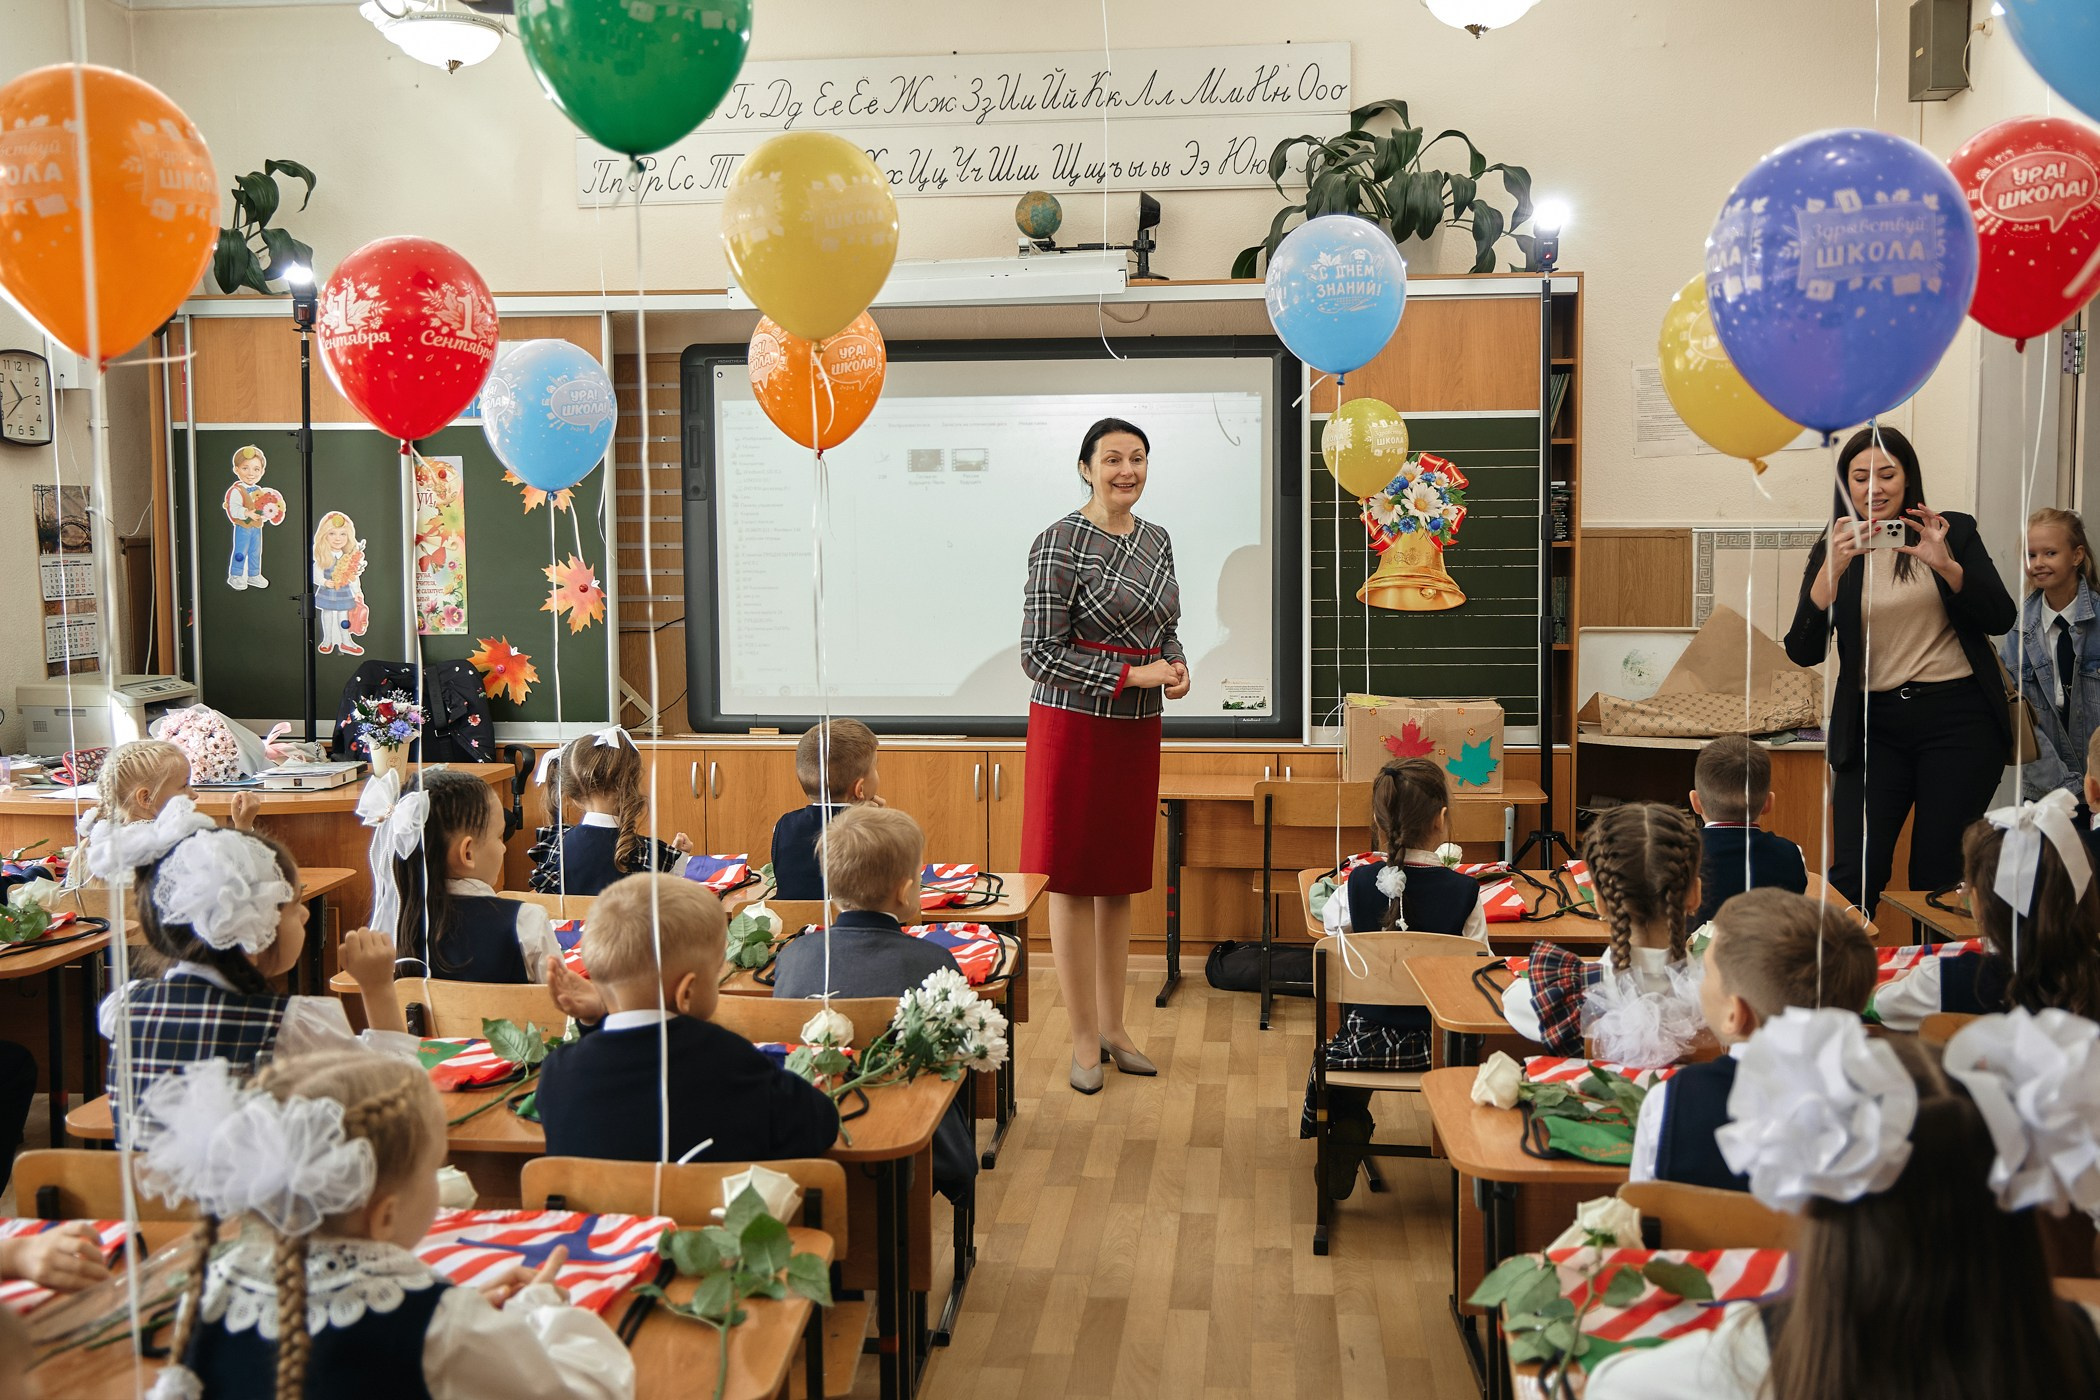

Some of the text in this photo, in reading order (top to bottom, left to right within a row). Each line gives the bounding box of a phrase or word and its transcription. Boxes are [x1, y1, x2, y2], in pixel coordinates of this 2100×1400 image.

[884, 75, 956, 114] Жж
[962, 77, 996, 125] Зз
[997, 73, 1037, 111] Ии
[1040, 67, 1079, 109] Йй
[1125, 69, 1175, 107] Лл
[1180, 67, 1245, 104] Мм
[1246, 64, 1292, 103] Нн
[668, 155, 695, 191] Сс
[699, 153, 745, 190] Т
[908, 148, 948, 192] Цц
[952, 146, 983, 182] Чч
[988, 144, 1040, 182] Шш
[1180, 140, 1210, 176] Ээ
[2012, 161, 2067, 186] УРА!
[1998, 179, 2089, 210] ШКОЛА!
[1816, 240, 1925, 269] ШКОЛА
[1320, 260, 1375, 280] С ДНЁМ
[1316, 280, 1382, 299] ЗНАНИЙ!
[334, 290, 355, 334] 1
[456, 294, 478, 340] 1
[420, 330, 494, 364] Сентября
[839, 344, 867, 359] УРА!
[831, 357, 876, 376] ШКОЛА!
[570, 389, 598, 402] УРА!
[562, 402, 607, 417] ШКОЛА!
[1376, 437, 1404, 446] ШКОЛА
